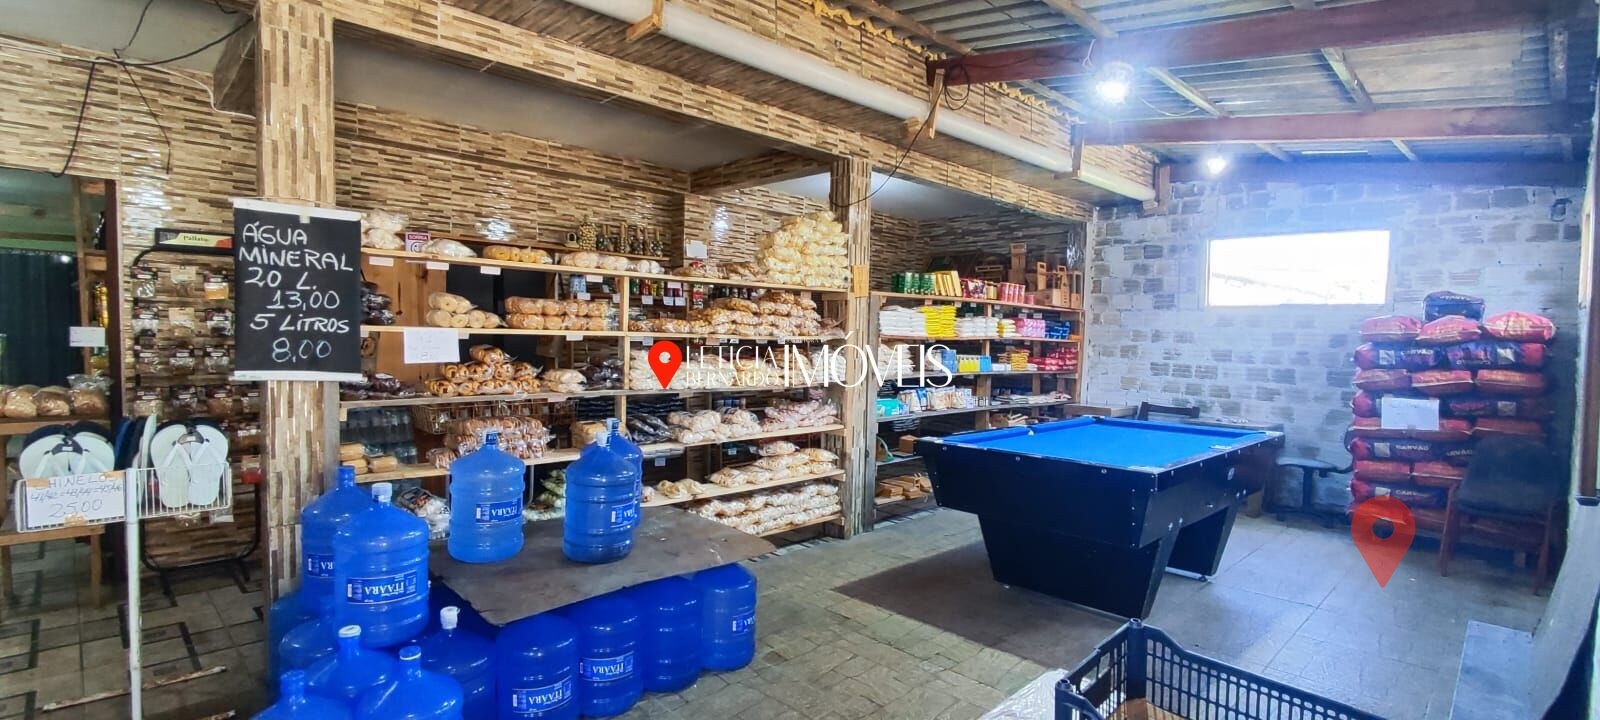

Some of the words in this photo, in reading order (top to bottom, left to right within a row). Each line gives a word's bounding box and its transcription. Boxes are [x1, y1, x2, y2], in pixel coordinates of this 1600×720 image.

[242, 221, 307, 245] ÁGUA
[238, 245, 353, 271] MINERAL
[245, 267, 281, 287] 20
[266, 290, 340, 311] 13,00
[250, 314, 276, 330] 5
[279, 314, 350, 333] LITROS
[272, 337, 332, 363] 8,00
[364, 582, 404, 596] ITAARA
